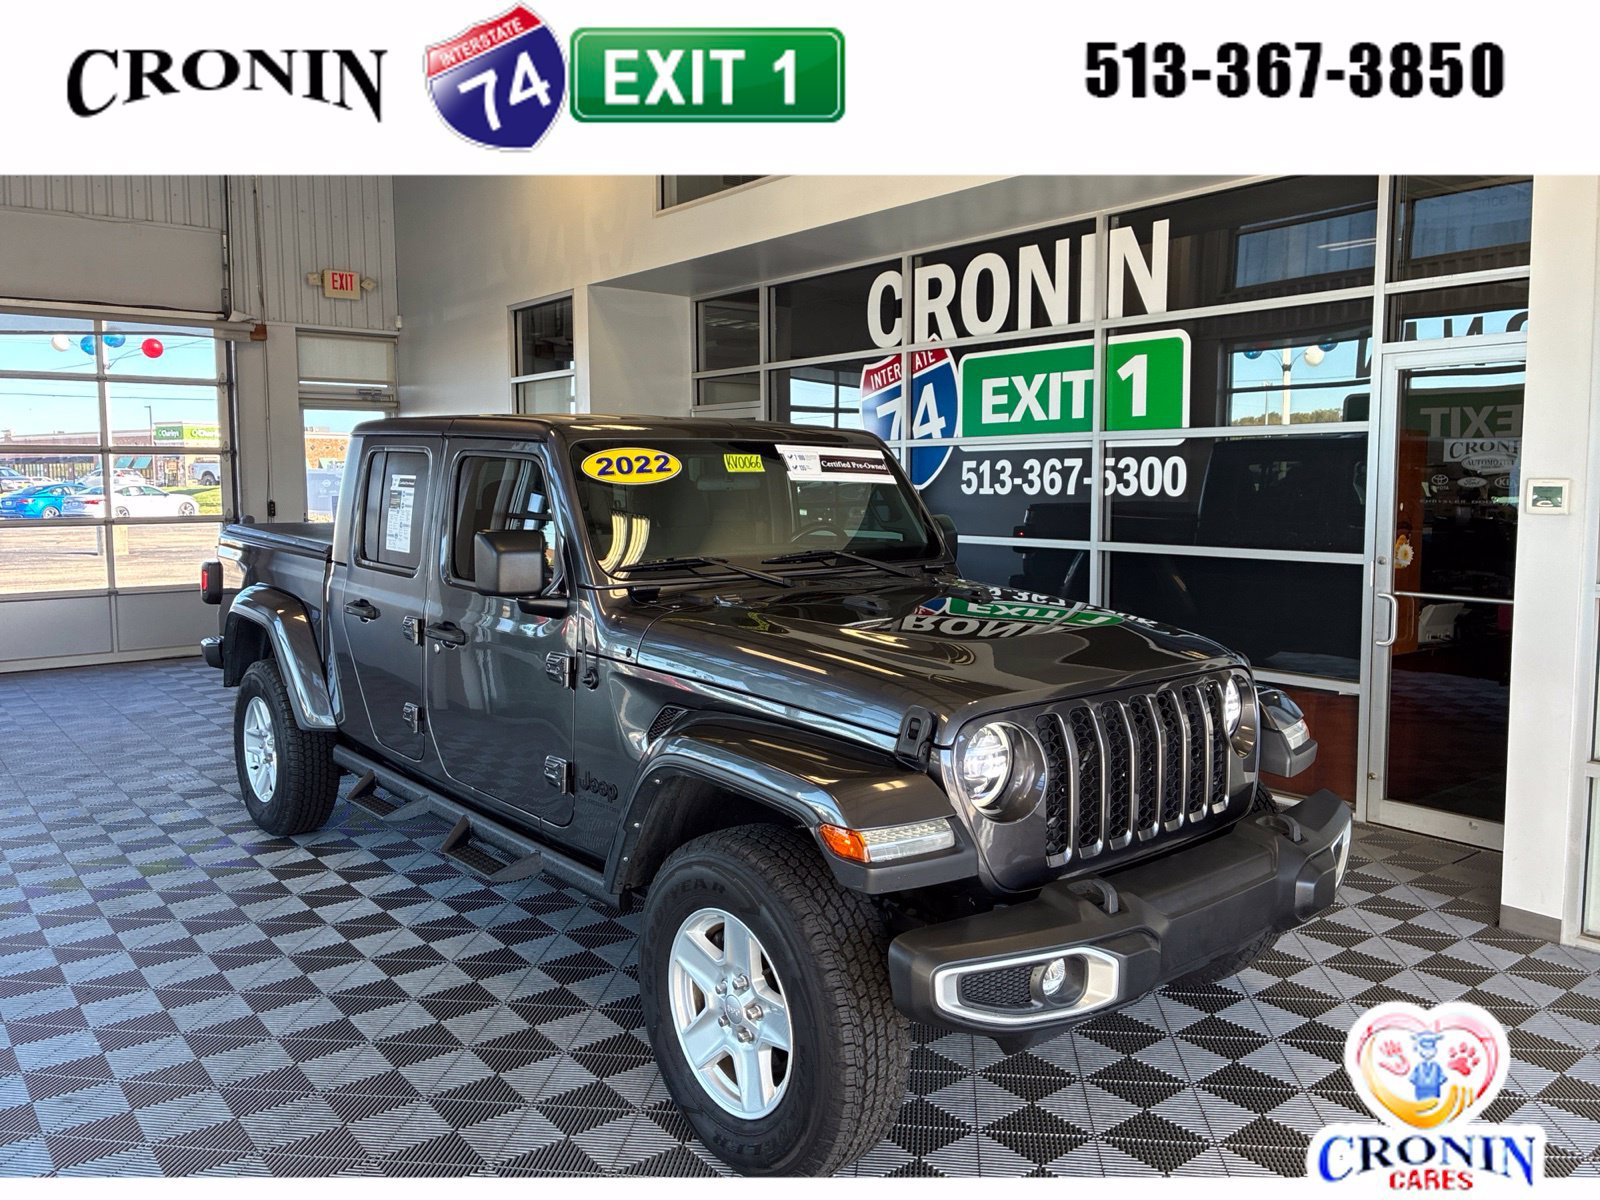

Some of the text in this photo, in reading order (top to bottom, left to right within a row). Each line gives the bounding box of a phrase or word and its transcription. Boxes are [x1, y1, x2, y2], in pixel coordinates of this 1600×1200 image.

[331, 272, 354, 291] EXIT
[867, 218, 1170, 348] CRONIN
[870, 351, 936, 390] INTERATE
[981, 353, 1149, 424] EXIT 1
[876, 382, 947, 460] 74
[596, 454, 672, 476] 2022
[727, 454, 762, 469] KV0066
[821, 460, 851, 469] Certified
[852, 461, 887, 471] Pre-Owned
[960, 456, 1188, 497] 513-367-5300
[579, 771, 618, 803] Jeep
